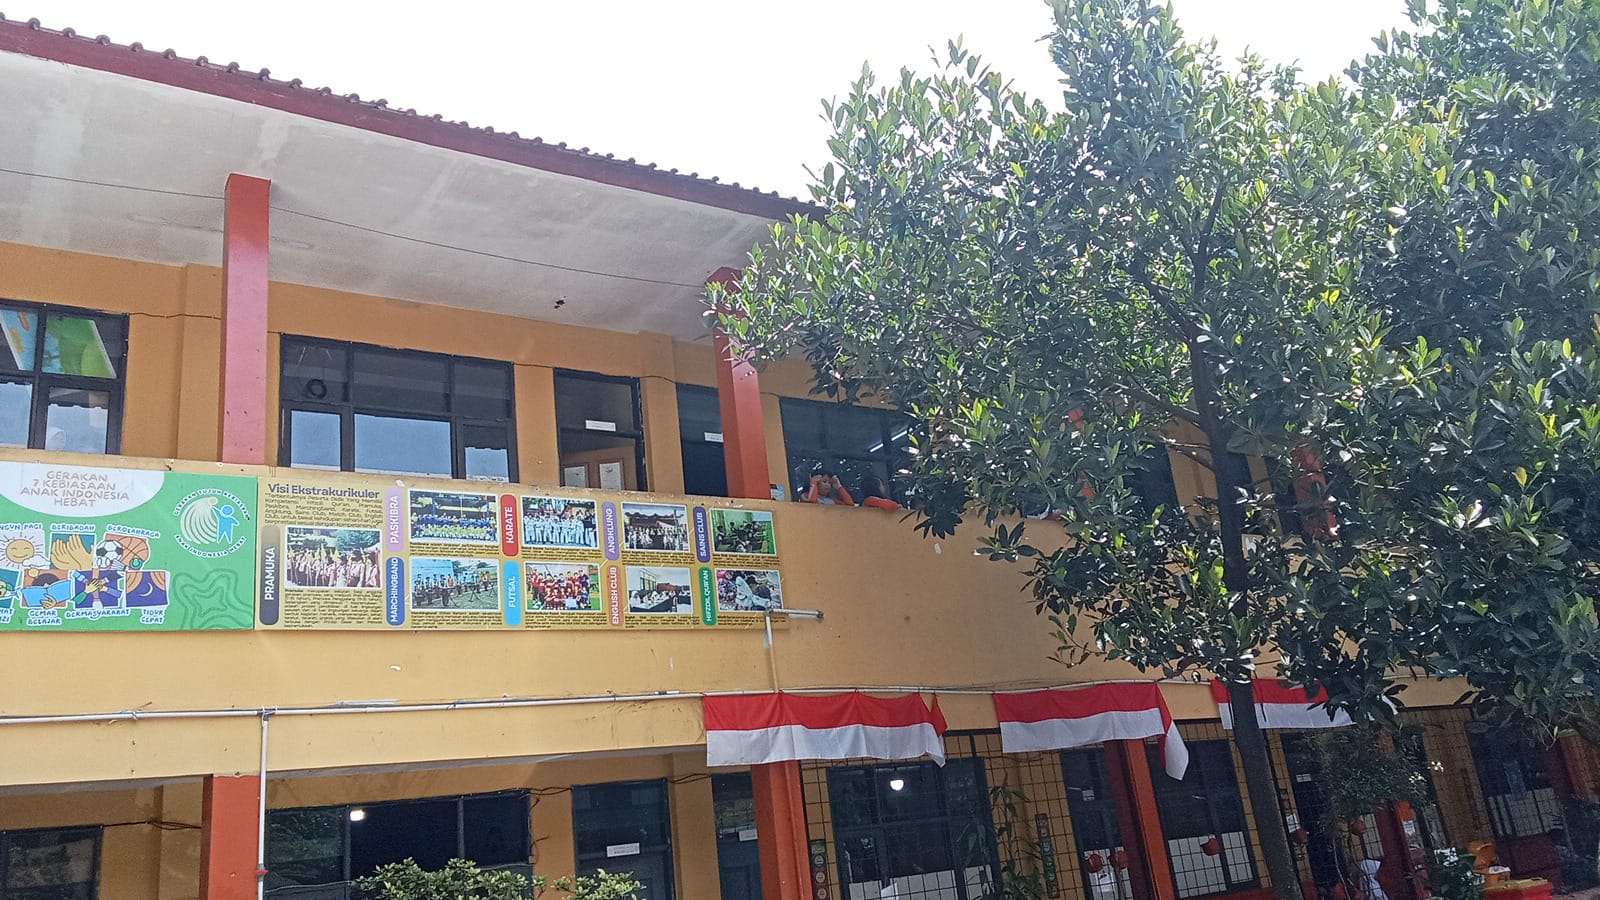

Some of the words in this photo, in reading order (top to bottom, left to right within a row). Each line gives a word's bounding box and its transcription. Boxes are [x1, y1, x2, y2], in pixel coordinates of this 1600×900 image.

[33, 479, 39, 487] 7
[43, 480, 116, 490] KEBIASAAN
[47, 470, 108, 482] GERAKAN
[20, 487, 58, 497] ANAK
[62, 489, 129, 500] INDONESIA
[268, 483, 289, 494] Visi
[291, 485, 380, 499] Ekstrakurikuler
[54, 498, 96, 507] HEBAT
[389, 495, 399, 544] PASKIBRA
[505, 507, 515, 544] KARATE
[696, 512, 704, 533] CLUB
[107, 525, 160, 538] BEROLAHRAGA
[606, 508, 616, 554] ANGKLUNG
[699, 534, 707, 557] SAINS
[264, 547, 275, 600] PRAMUKA
[609, 567, 617, 588] CLUB
[390, 558, 399, 623] MARCHINGBAND
[508, 576, 516, 608] FUTSAL
[66, 609, 130, 619] BERMASYARAKAT
[611, 590, 620, 624] ENGLISH
